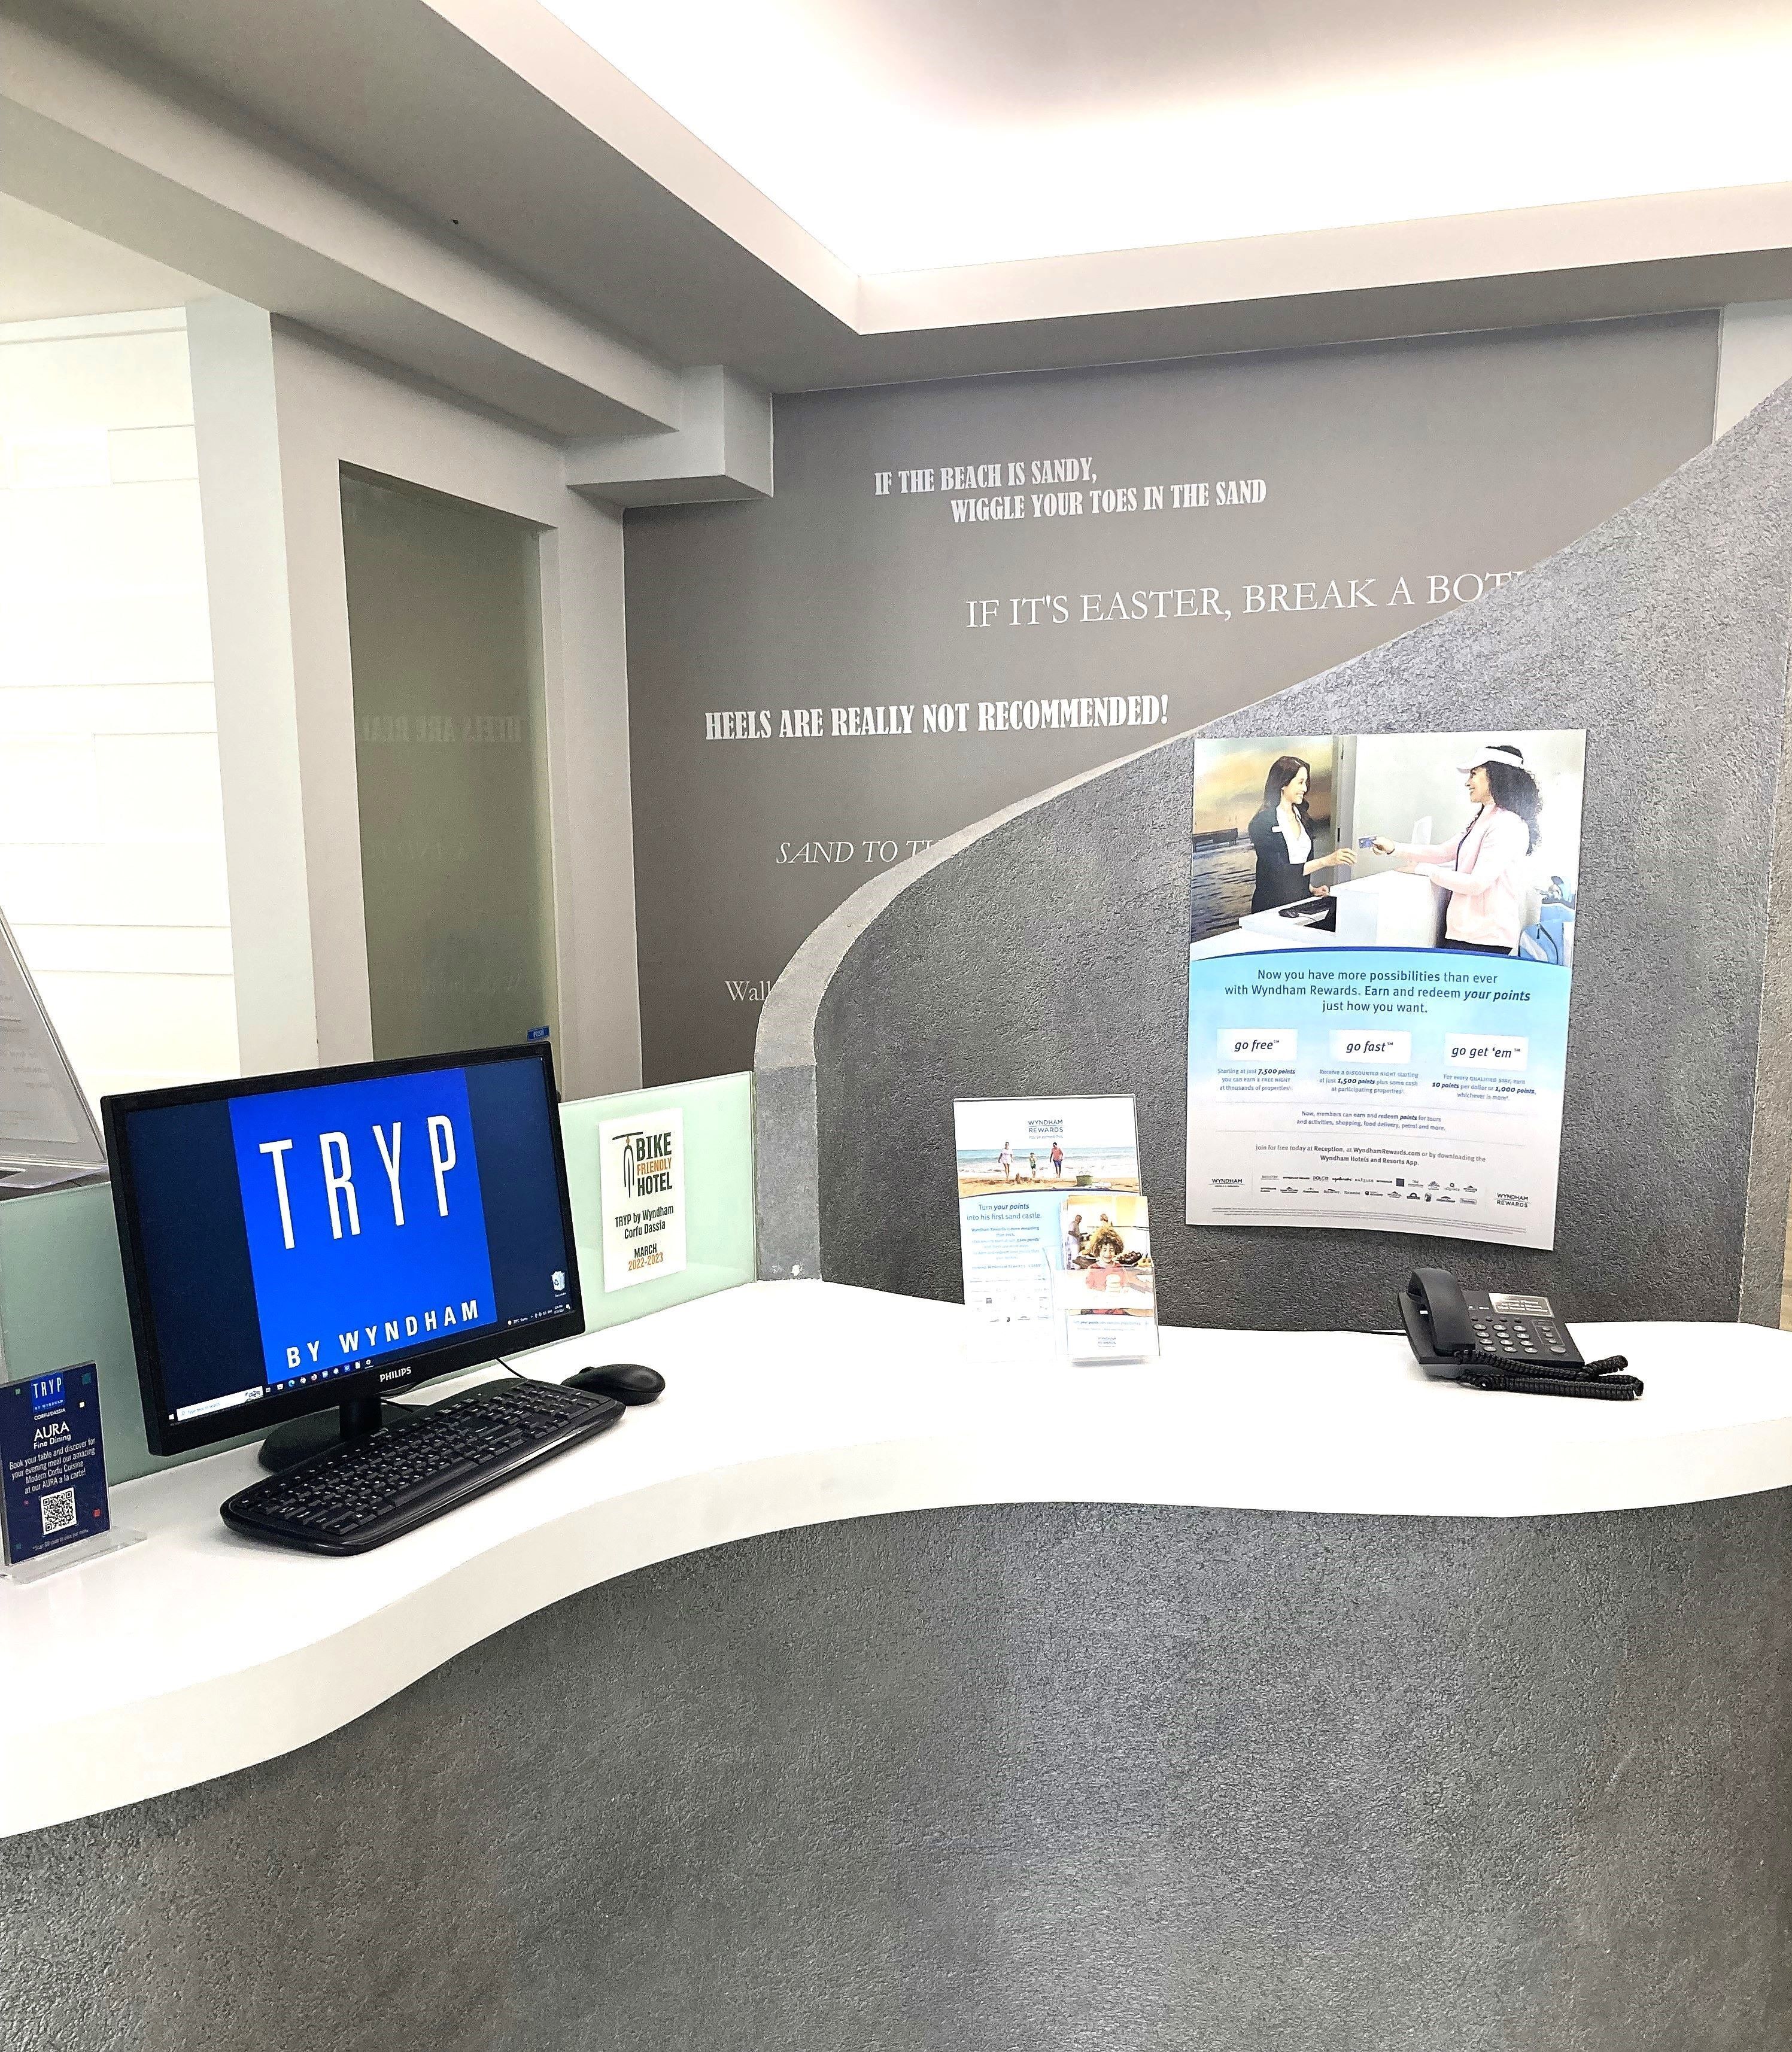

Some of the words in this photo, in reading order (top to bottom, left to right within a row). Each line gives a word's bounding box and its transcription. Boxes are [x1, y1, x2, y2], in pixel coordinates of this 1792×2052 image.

[874, 472, 892, 495] IF
[898, 469, 936, 494] THE
[940, 463, 1002, 491] BEACH
[1007, 461, 1025, 487] IS
[1031, 457, 1097, 485] SANDY,
[950, 495, 1025, 523] WIGGLE
[1031, 491, 1083, 518] YOUR
[1089, 487, 1137, 514] TOES
[1143, 485, 1164, 510] IN
[1170, 483, 1210, 509] THE
[1216, 479, 1267, 506] SAND
[965, 599, 1000, 628] IF
[1009, 593, 1070, 626] IT'S
[1079, 587, 1231, 622] EASTER,
[1242, 579, 1378, 615] BREAK
[1386, 575, 1416, 606] A
[1426, 570, 1527, 605] BOT
[704, 710, 771, 740] HEELS
[779, 709, 823, 738] ARE
[831, 704, 915, 736] REALLY
[922, 703, 970, 734] NOT
[977, 694, 1168, 732] RECOMMENDED!
[776, 841, 854, 864] SAND
[862, 840, 898, 862] TO
[906, 840, 933, 856] T
[1258, 969, 1281, 980] Now
[1284, 971, 1305, 982] you
[1308, 969, 1335, 980] have
[1338, 971, 1366, 980] more
[1370, 970, 1440, 983] possibilities
[1444, 972, 1469, 983] than
[1473, 975, 1498, 984] ever
[1225, 984, 1248, 995] with
[1252, 984, 1306, 997] Wyndham
[1310, 985, 1361, 996] Rewards.
[1365, 986, 1389, 996] Earn
[1393, 987, 1414, 996] and
[1417, 987, 1460, 998] redeem
[1463, 990, 1492, 1001] your
[1493, 990, 1531, 1002] points
[1322, 1000, 1344, 1013] just
[1347, 1001, 1370, 1011] how
[1372, 1004, 1393, 1014] you
[1397, 1003, 1427, 1013] want.
[533, 1028, 545, 1038] PUSH
[1234, 1041, 1249, 1052] go
[1346, 1043, 1361, 1053] go
[1451, 1047, 1466, 1057] go
[1469, 1047, 1489, 1059] get
[636, 1132, 672, 1162] BIKE
[1353, 1147, 1420, 1156] WyndhamRewards.com
[1437, 1152, 1475, 1162] downloading
[637, 1157, 672, 1176] FRIENDLY
[259, 1114, 457, 1250] TRYP
[637, 1171, 673, 1197] HOTEL
[1497, 1193, 1529, 1201] WYNDHAM
[615, 1214, 631, 1228] TRYP
[633, 1212, 641, 1224] by
[642, 1205, 674, 1221] Wyndham
[624, 1226, 642, 1239] Corfu
[644, 1220, 666, 1235] Dassia
[634, 1242, 657, 1259] MARCH
[628, 1252, 663, 1272] 2022-2023
[286, 1340, 320, 1369] BY
[338, 1299, 479, 1354] WYNDHAM
[379, 1366, 412, 1382] PHILIPS
[33, 1377, 62, 1399] TRYP
[34, 1412, 50, 1421] CORFU
[50, 1407, 66, 1416] DASSIA
[34, 1421, 70, 1442] AURA
[34, 1441, 48, 1449] Fine
[49, 1434, 71, 1445] Dining
[9, 1459, 24, 1470] Book
[25, 1456, 37, 1467] your
[38, 1451, 52, 1461] table
[53, 1446, 63, 1457] and
[64, 1440, 87, 1453] discover
[11, 1470, 24, 1481] your
[25, 1463, 47, 1475] evening
[47, 1457, 62, 1468] meal
[62, 1455, 72, 1463] our
[72, 1448, 96, 1460] amazing
[25, 1472, 47, 1484] Modern
[48, 1467, 63, 1478] Corfu
[63, 1461, 84, 1472] Cuisine
[32, 1483, 41, 1492] our
[42, 1477, 58, 1488] AURA
